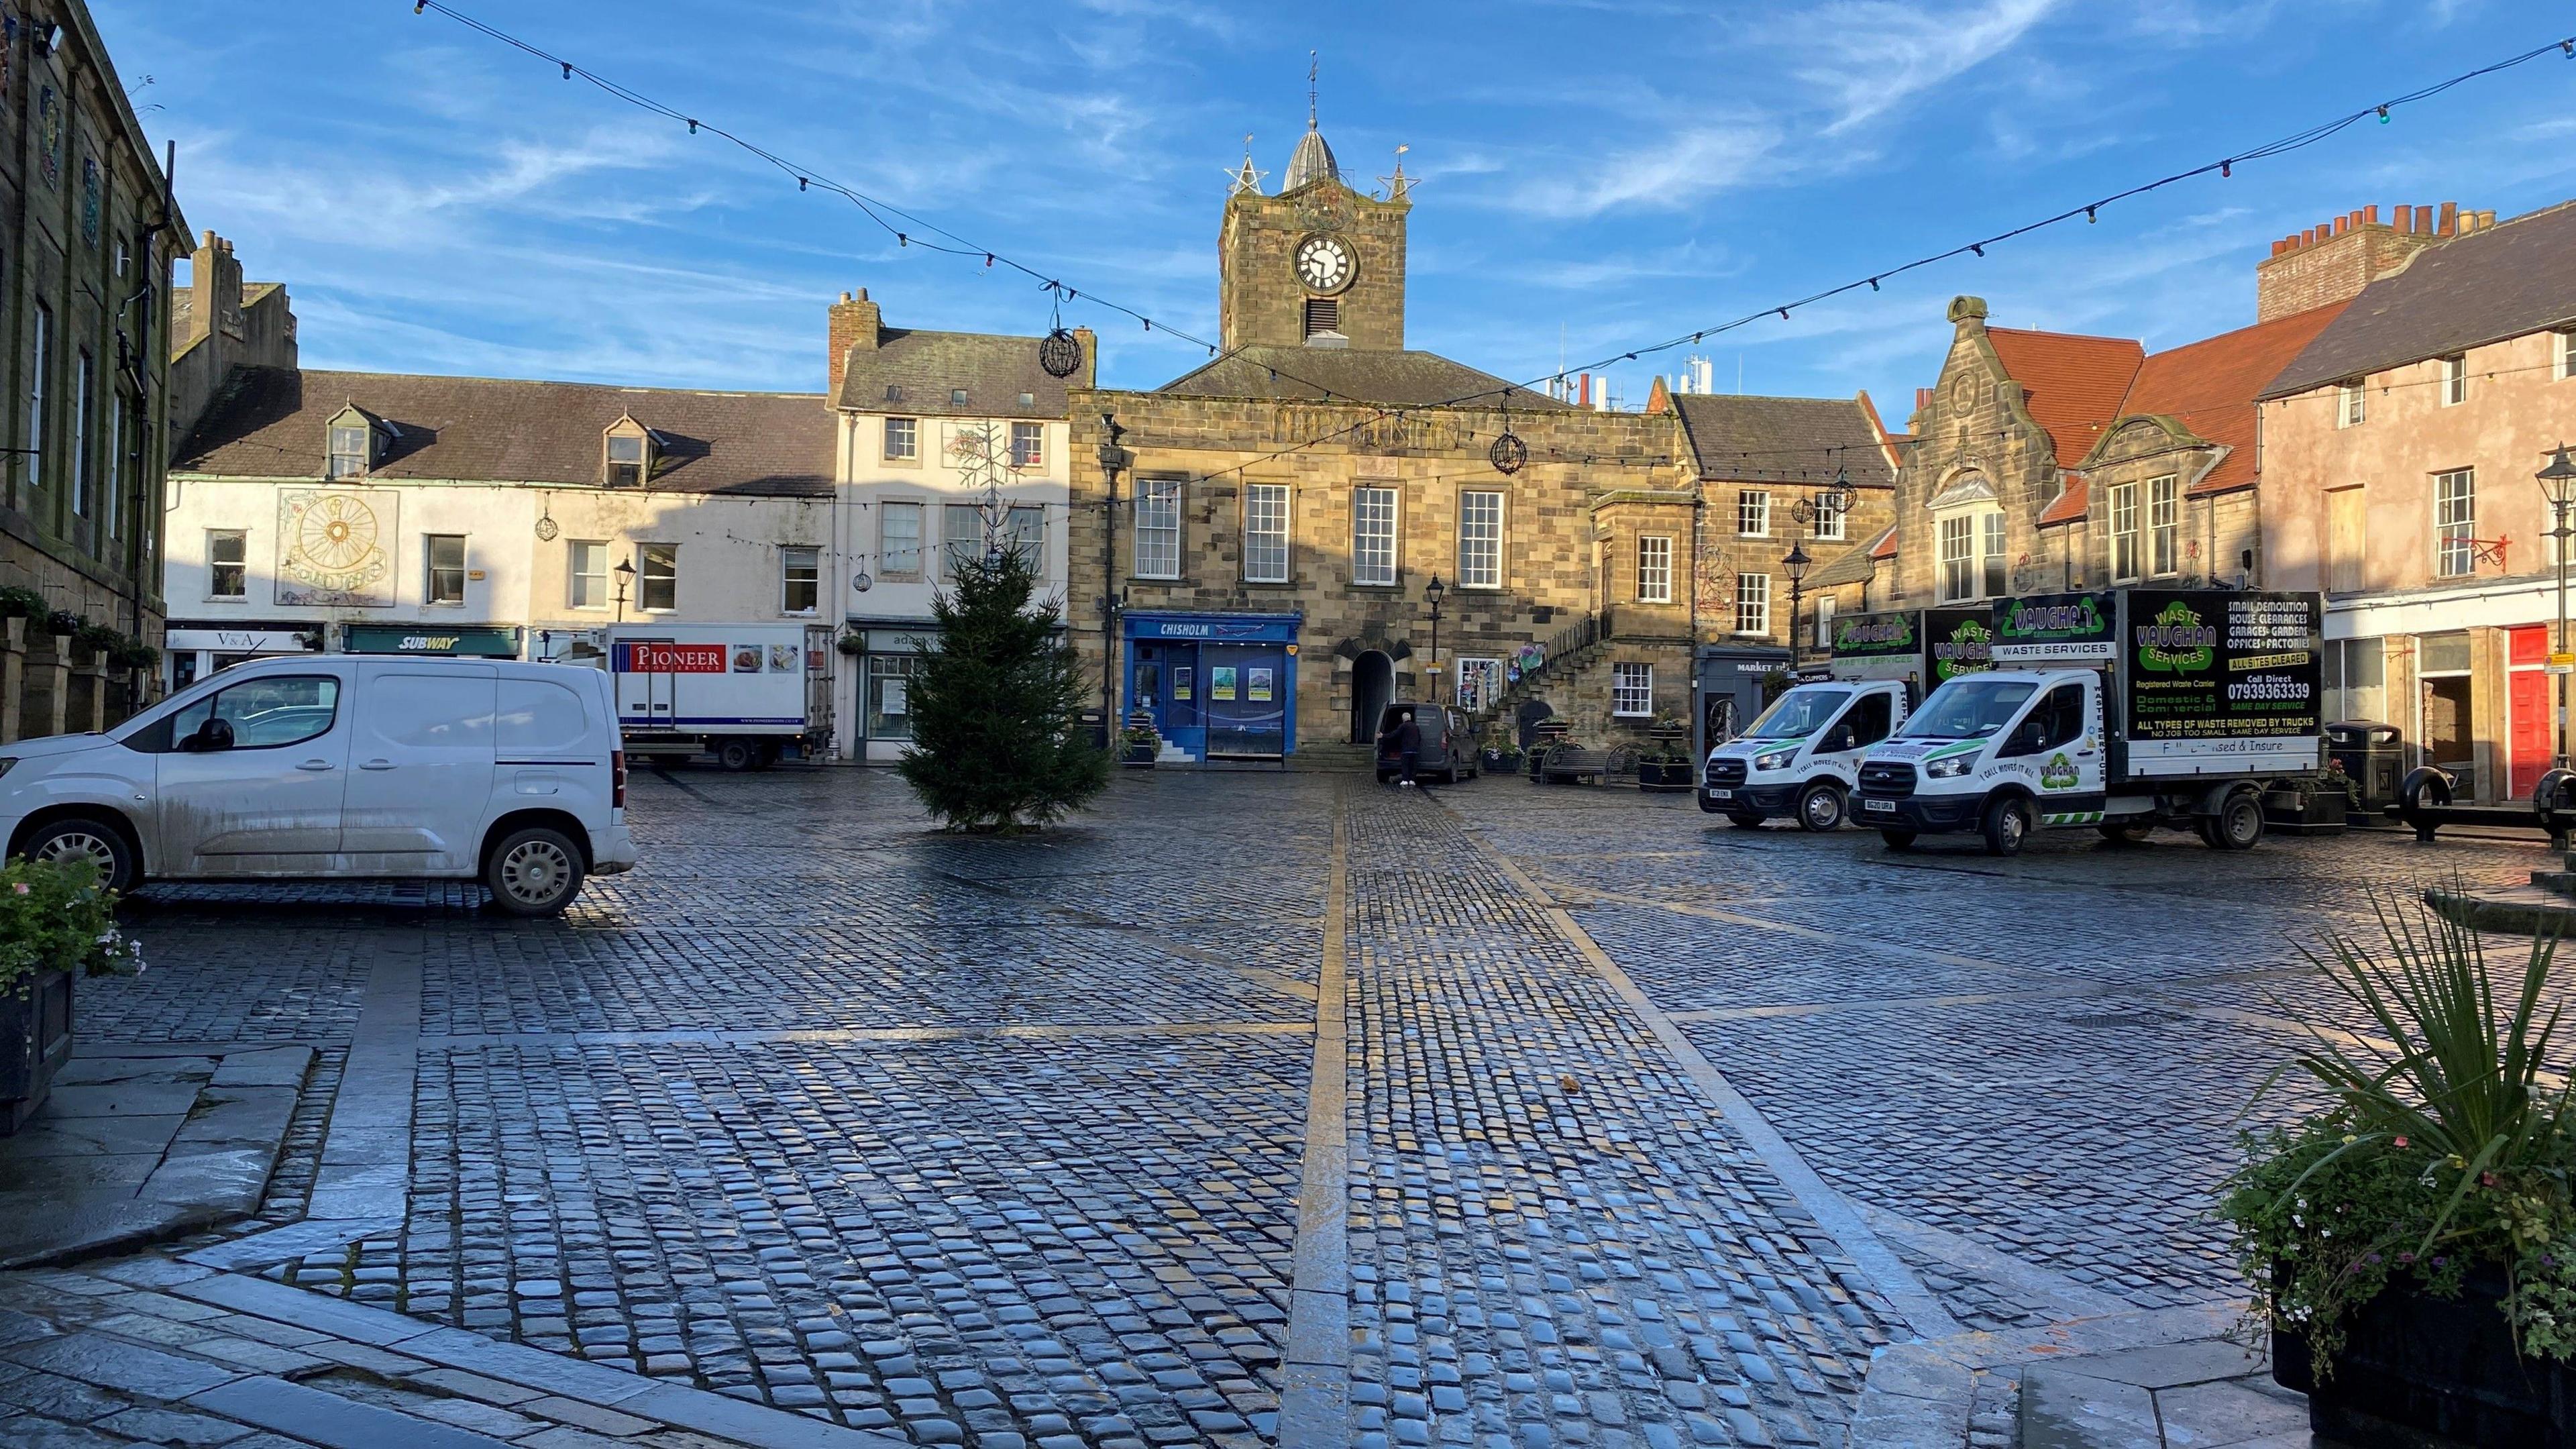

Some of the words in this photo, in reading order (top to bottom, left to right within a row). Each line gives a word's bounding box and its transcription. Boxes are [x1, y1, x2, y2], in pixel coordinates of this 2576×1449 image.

[2229, 601, 2253, 612] SMALL
[2257, 601, 2308, 612] DEMOLITION
[2155, 609, 2202, 625] WASTE
[2229, 614, 2255, 624] HOUSE
[2259, 614, 2307, 624] CLEARANCES
[1160, 623, 1209, 636] CHISHOLM
[1950, 627, 1992, 640] WASTE
[2229, 626, 2266, 636] GARAGES
[2271, 626, 2308, 636] GARDENS
[2137, 625, 2216, 647] VAUGHAN
[398, 636, 460, 650] SUBWAY
[2227, 639, 2260, 649] OFFICES
[2266, 639, 2310, 649] FACTORIES
[637, 646, 720, 665] PIONEER
[1934, 642, 1993, 659] VAUGHA
[2003, 646, 2041, 655] WASTE
[2045, 644, 2107, 654] SERVICES
[2148, 648, 2205, 664] SERVICES
[2232, 660, 2247, 669] ALL
[2248, 657, 2269, 667] SITES
[2271, 653, 2306, 665] CLEARED
[2247, 675, 2262, 683] Call
[2266, 674, 2292, 682] Direct
[2136, 680, 2171, 690] Registered
[2228, 683, 2310, 699] 07939363339
[2094, 686, 2103, 720] WASTE
[2137, 695, 2201, 704] Domestic
[2206, 694, 2216, 702] &
[2231, 702, 2253, 710] SAME
[2271, 702, 2306, 710] SERVICE
[2137, 720, 2153, 730] ALL
[2155, 720, 2182, 729] TYPES
[2184, 720, 2195, 729] OF
[2197, 719, 2226, 729] WASTE
[2227, 718, 2267, 728] REMOVED
[2269, 718, 2280, 727] BY
[2282, 717, 2314, 726] TRUCKS
[2239, 740, 2246, 751] &
[2098, 727, 2106, 782] SERVICES
[1801, 762, 1813, 772] CALL
[1984, 766, 1998, 778] CALL
[2040, 765, 2080, 776] VAUGHAN
